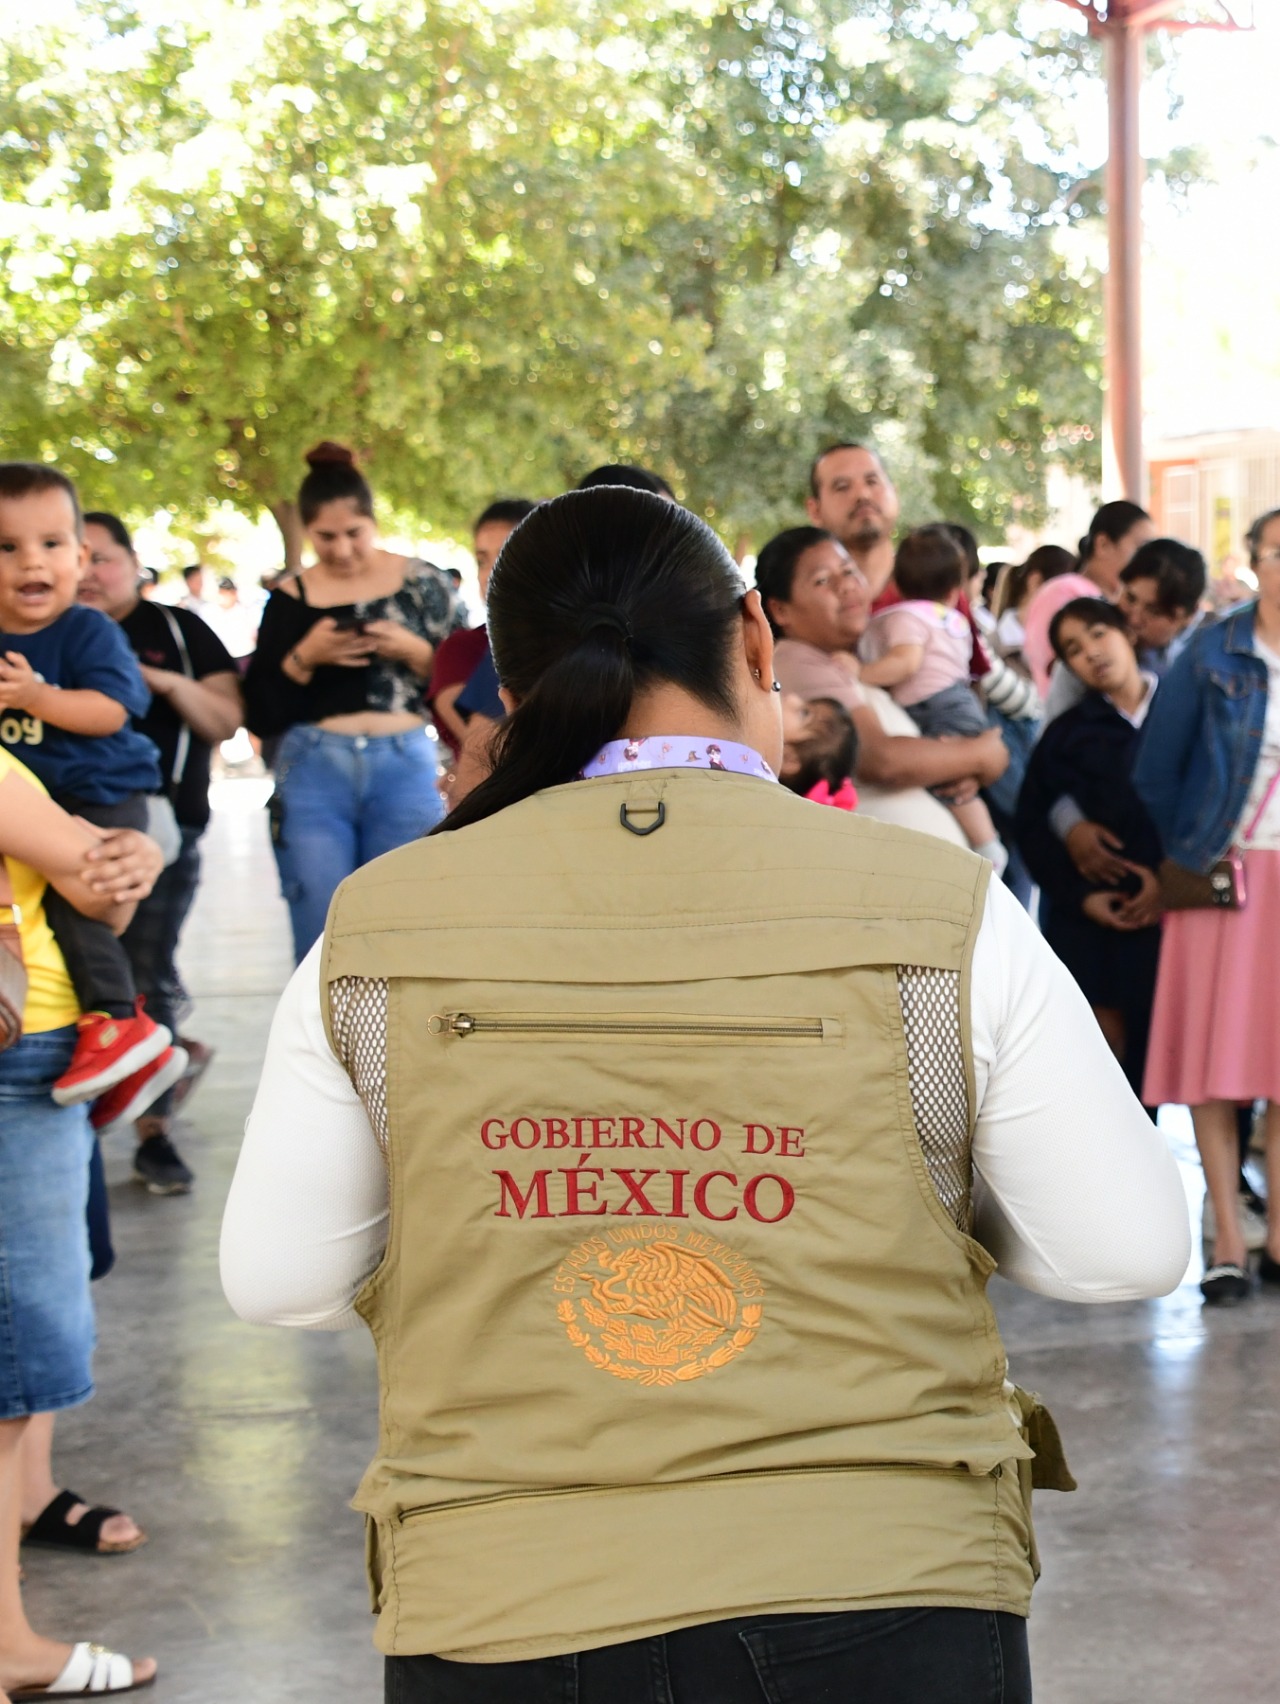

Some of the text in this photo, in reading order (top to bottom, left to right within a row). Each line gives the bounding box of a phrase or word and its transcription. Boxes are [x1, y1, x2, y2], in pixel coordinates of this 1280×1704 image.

[480, 1117, 806, 1157] GOBIERNO DE
[492, 1153, 795, 1223] MÉXICO
[553, 1224, 766, 1298] ESTADOS UNIDOS MEXICANOS
